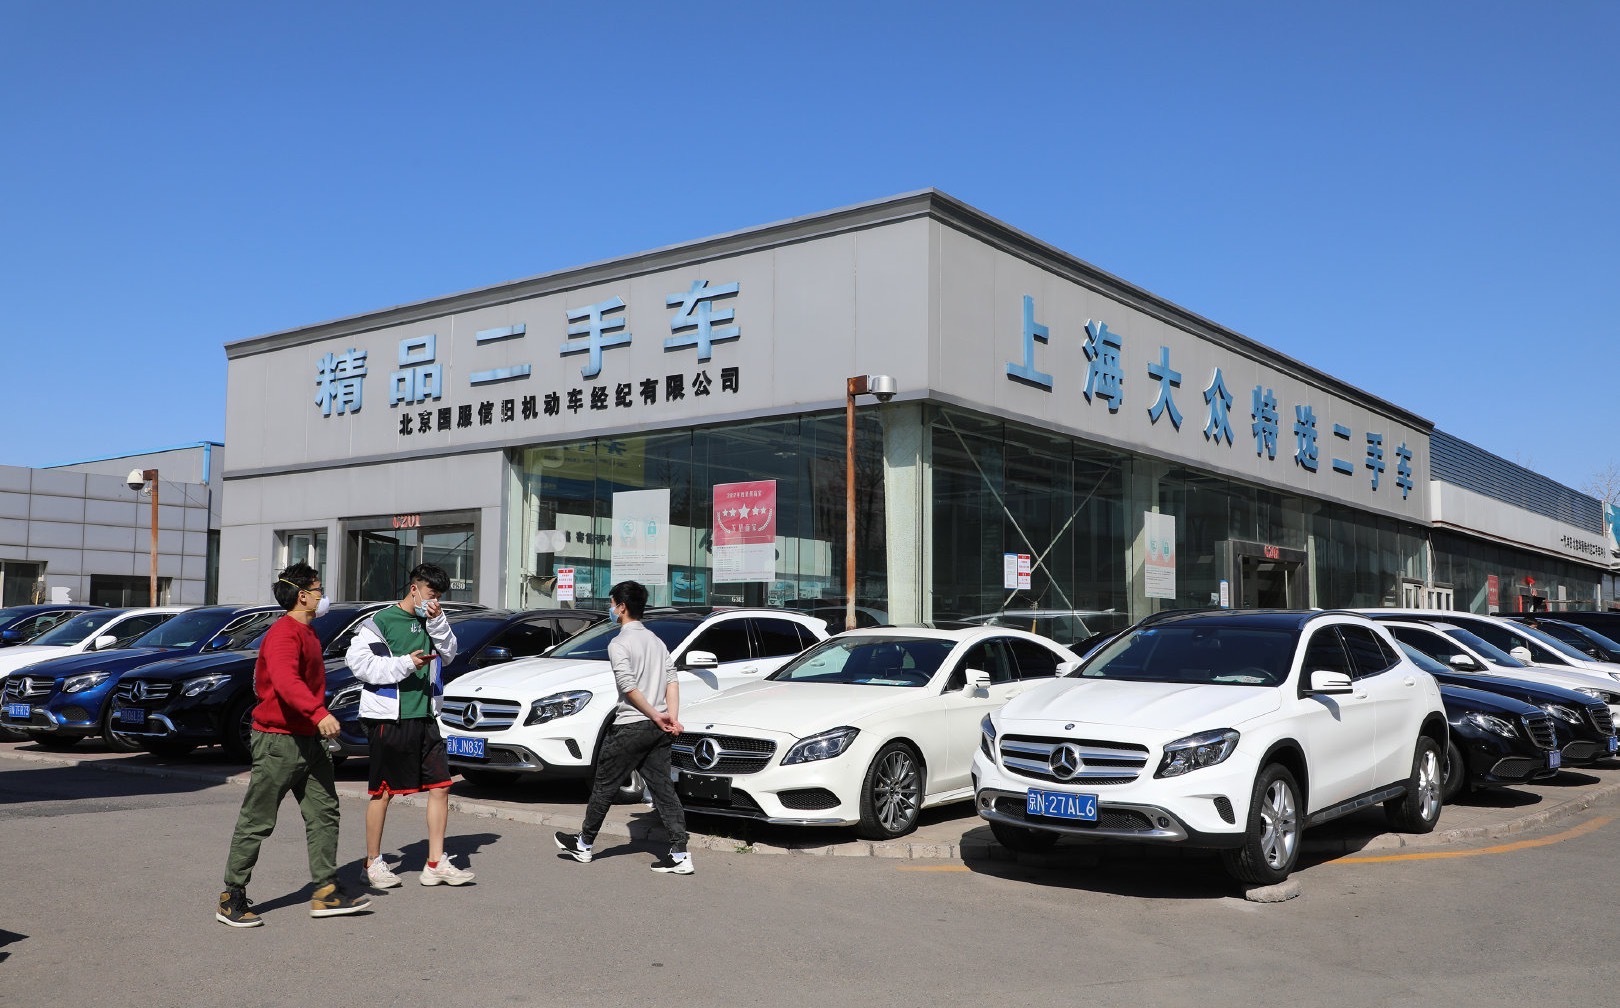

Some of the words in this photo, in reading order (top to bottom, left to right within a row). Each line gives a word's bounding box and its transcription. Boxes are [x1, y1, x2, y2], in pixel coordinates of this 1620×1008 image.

[314, 280, 741, 416] 精品二手车
[1006, 295, 1414, 499] 上海大众特选二手车
